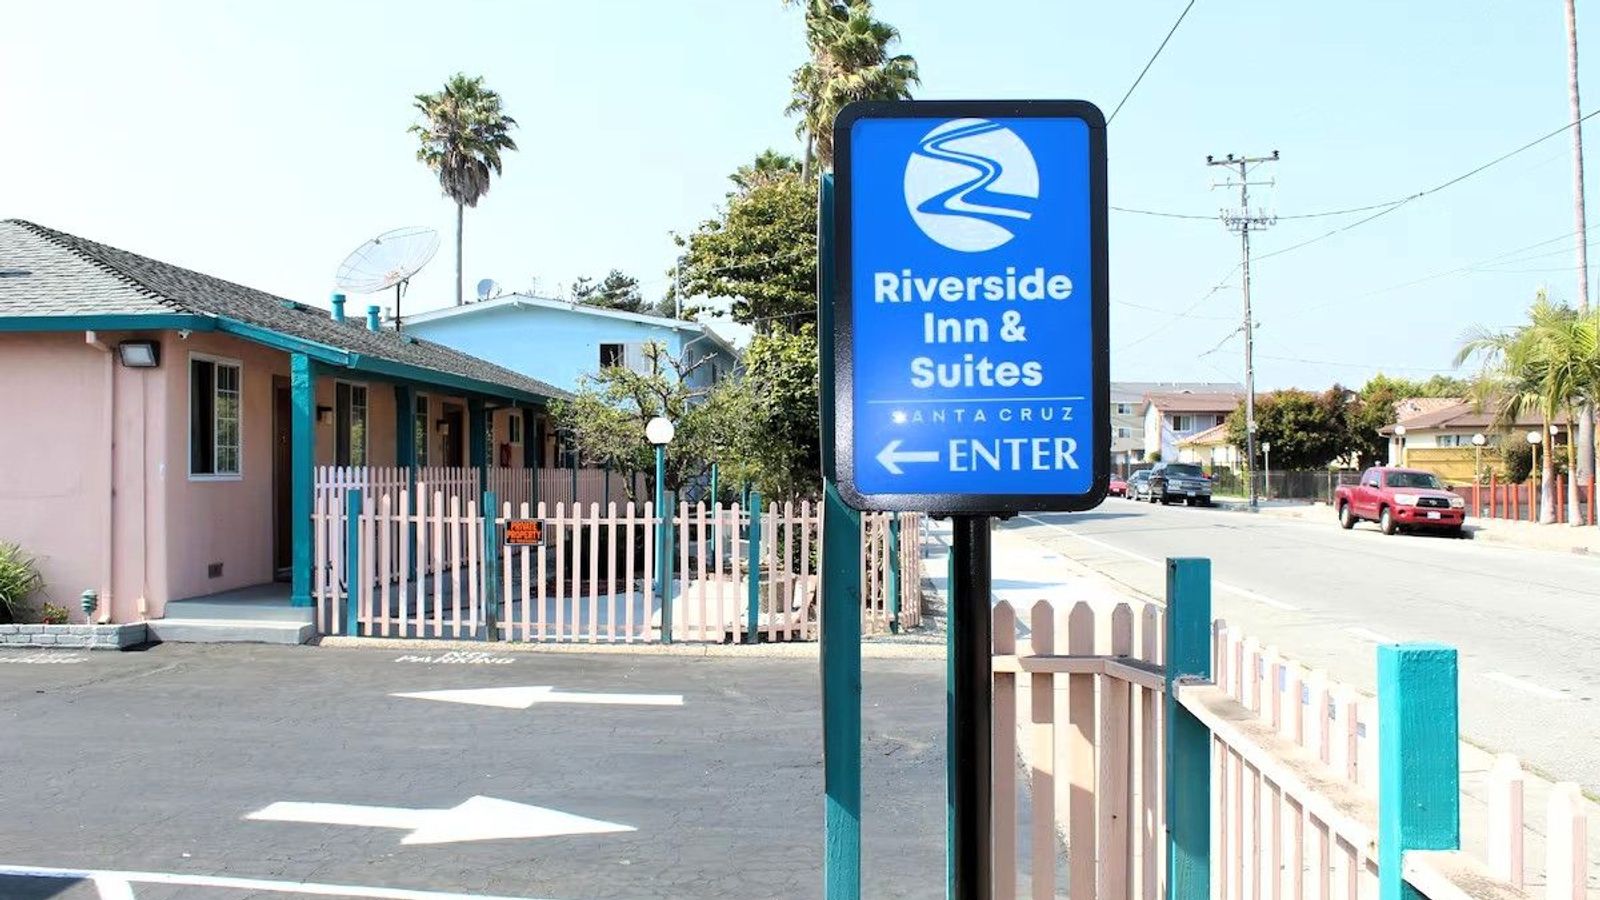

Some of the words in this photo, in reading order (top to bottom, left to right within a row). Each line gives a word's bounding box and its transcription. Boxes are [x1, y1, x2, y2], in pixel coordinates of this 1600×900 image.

[874, 266, 1073, 303] Riverside
[924, 312, 989, 344] Inn
[1000, 310, 1028, 343] &
[910, 353, 1044, 389] Suites
[999, 406, 1074, 422] CRUZ
[949, 437, 1080, 472] ENTER
